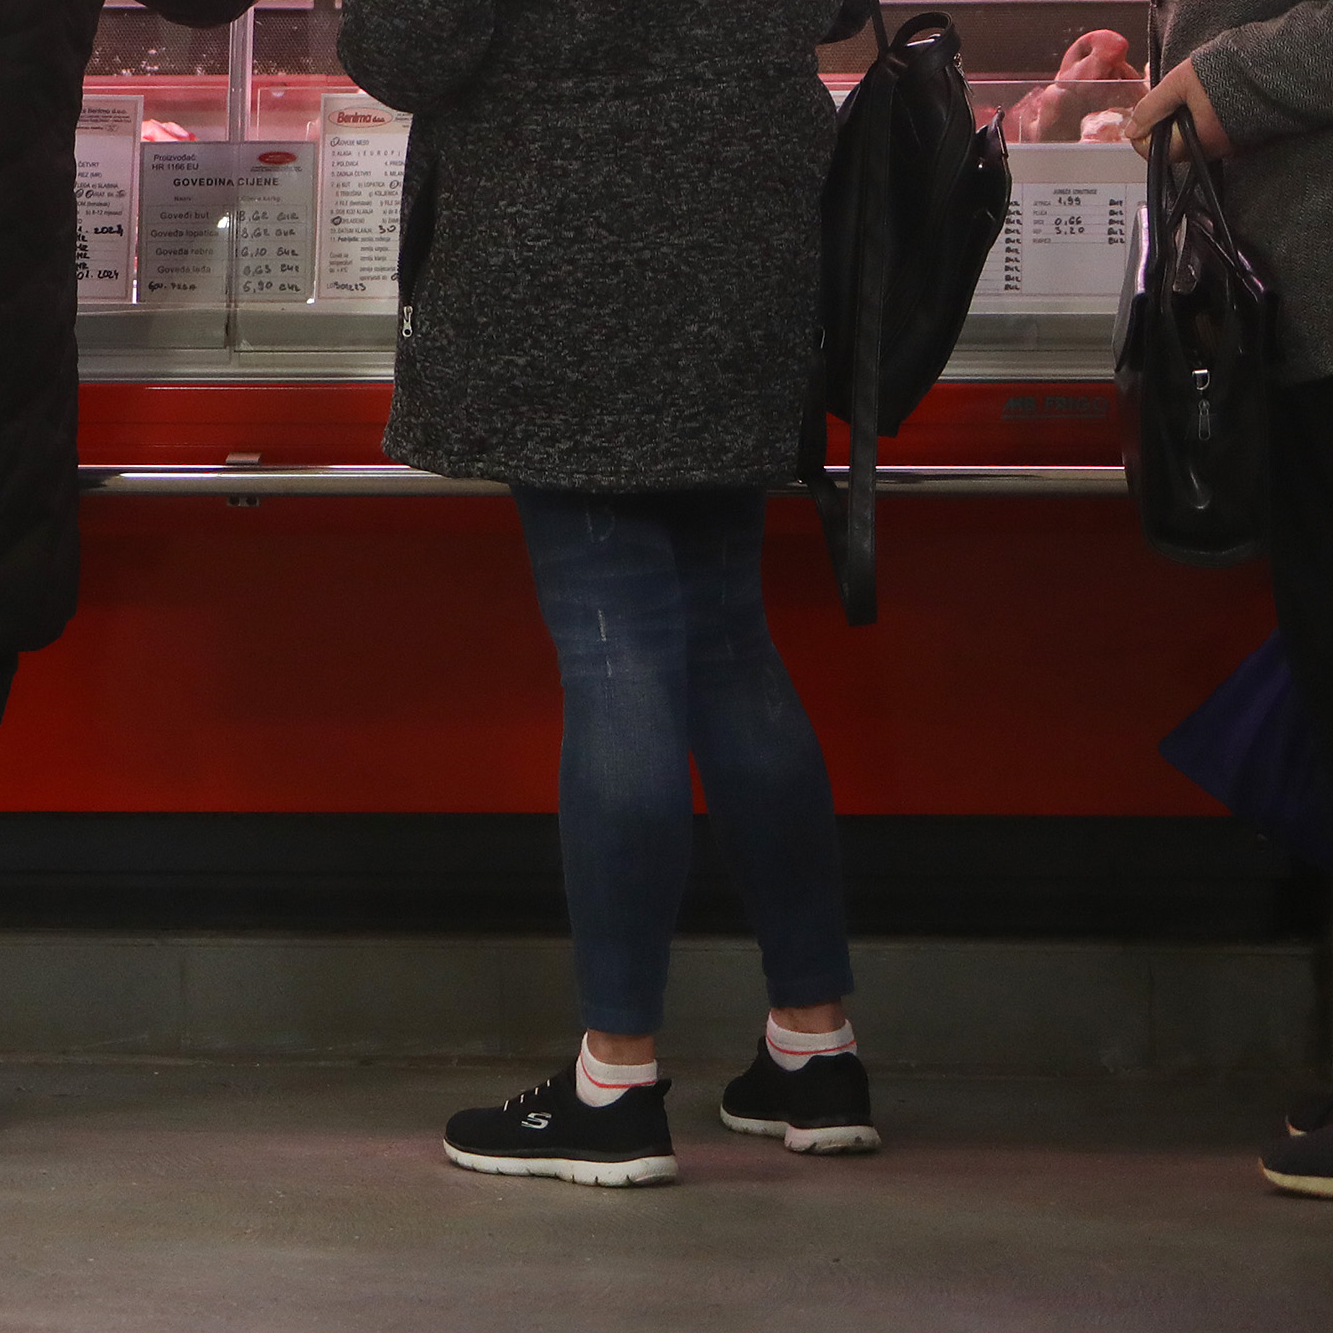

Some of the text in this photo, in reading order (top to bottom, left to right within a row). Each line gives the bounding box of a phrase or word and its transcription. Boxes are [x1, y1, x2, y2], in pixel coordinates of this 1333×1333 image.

[337, 112, 371, 124] Benima
[173, 178, 279, 187] GOVEDINA CIJENE
